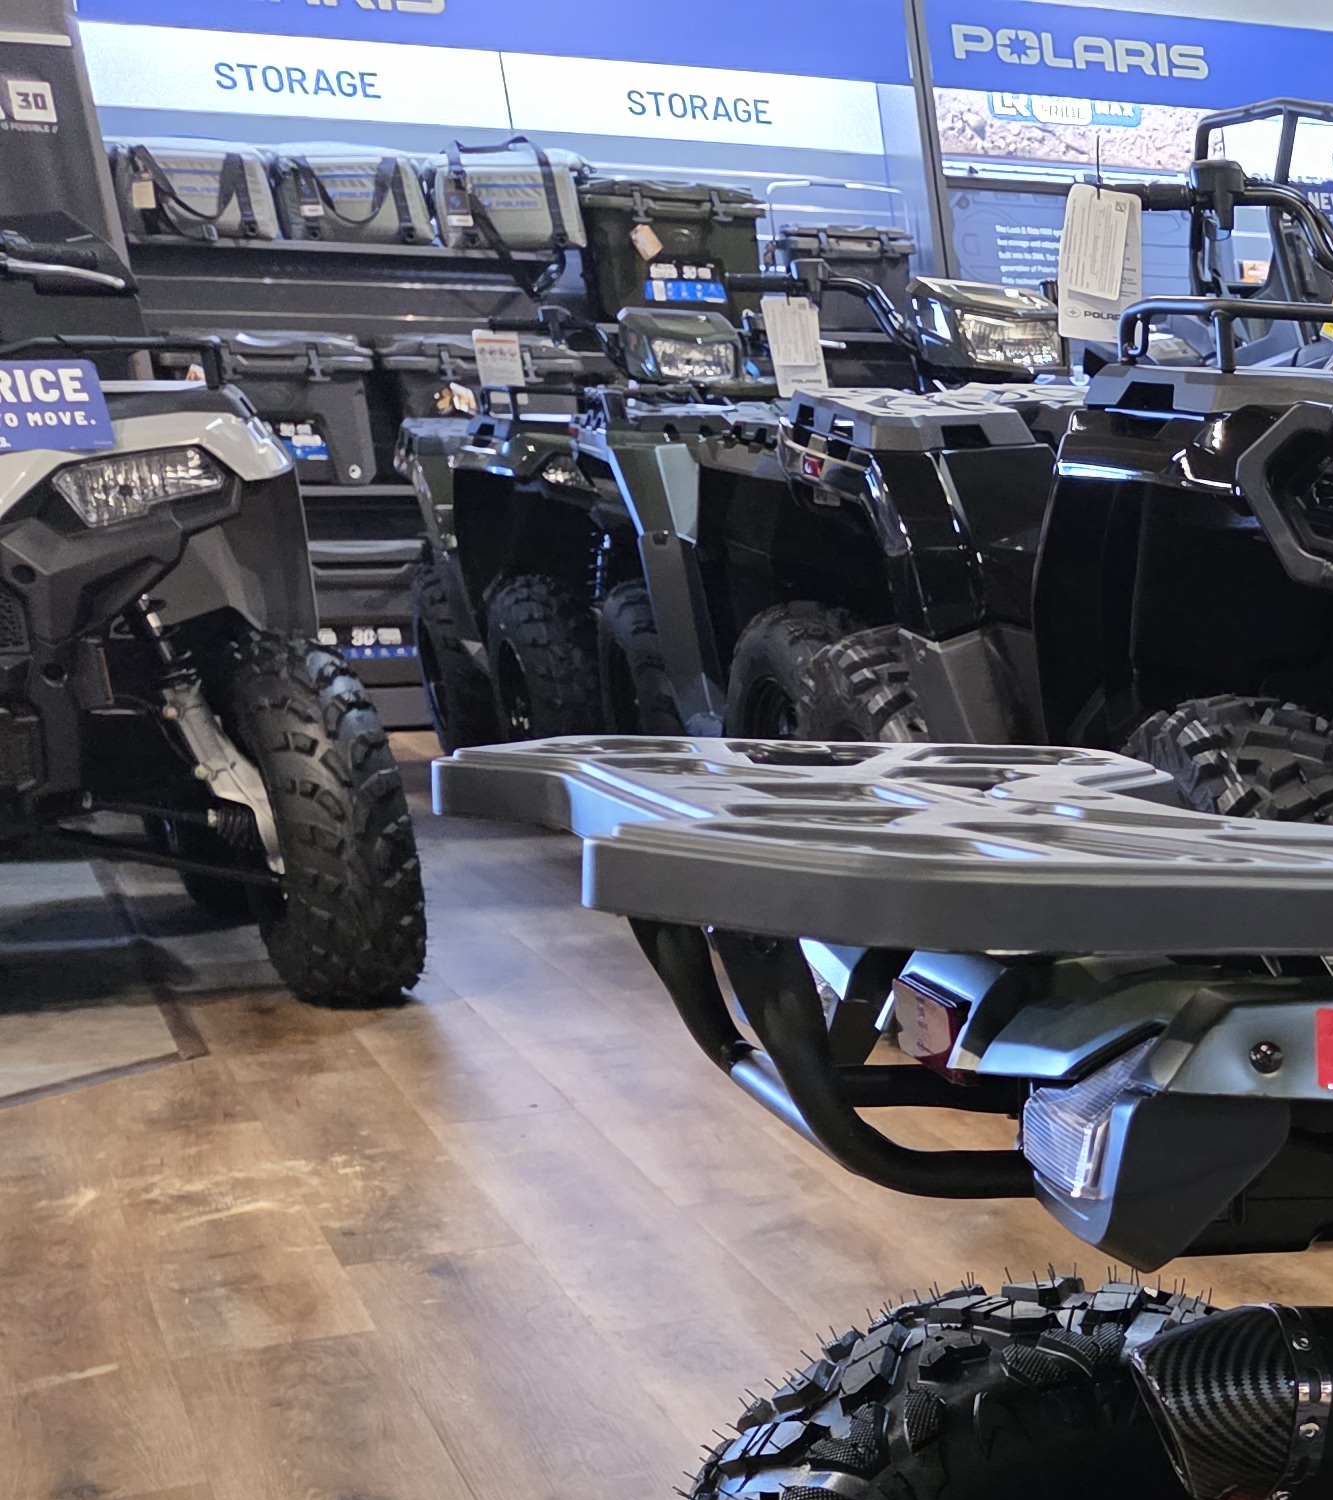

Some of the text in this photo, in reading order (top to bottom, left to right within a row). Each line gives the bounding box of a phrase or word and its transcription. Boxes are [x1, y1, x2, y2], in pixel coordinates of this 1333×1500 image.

[951, 23, 1209, 80] POLARIS
[213, 61, 382, 99] STORAGE
[15, 92, 48, 110] 30
[626, 90, 773, 125] STORAGE
[1083, 310, 1122, 320] POLAR
[26, 411, 97, 427] MOVE.
